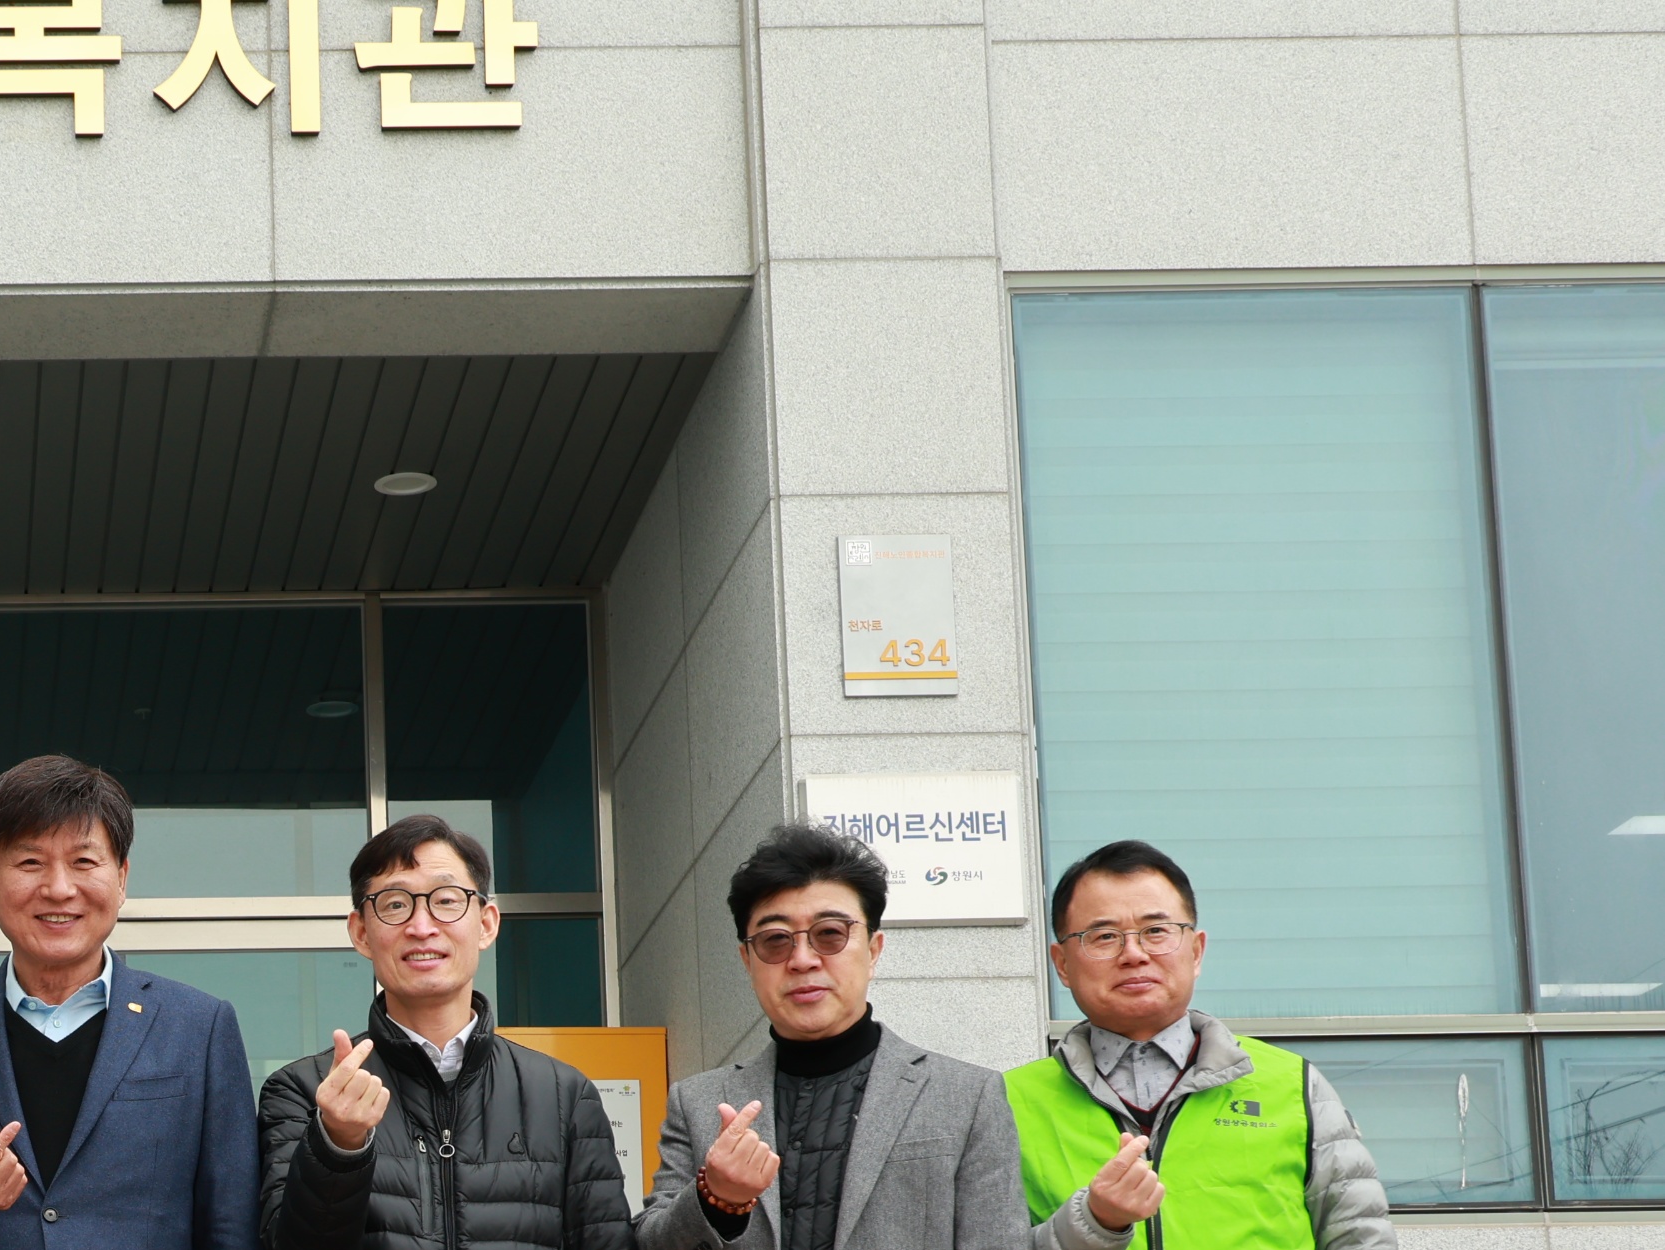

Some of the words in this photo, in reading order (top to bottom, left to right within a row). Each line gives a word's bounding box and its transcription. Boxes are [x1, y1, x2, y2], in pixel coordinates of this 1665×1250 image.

[847, 619, 883, 632] 천자로
[879, 638, 951, 667] 434
[951, 870, 983, 882] 창원시
